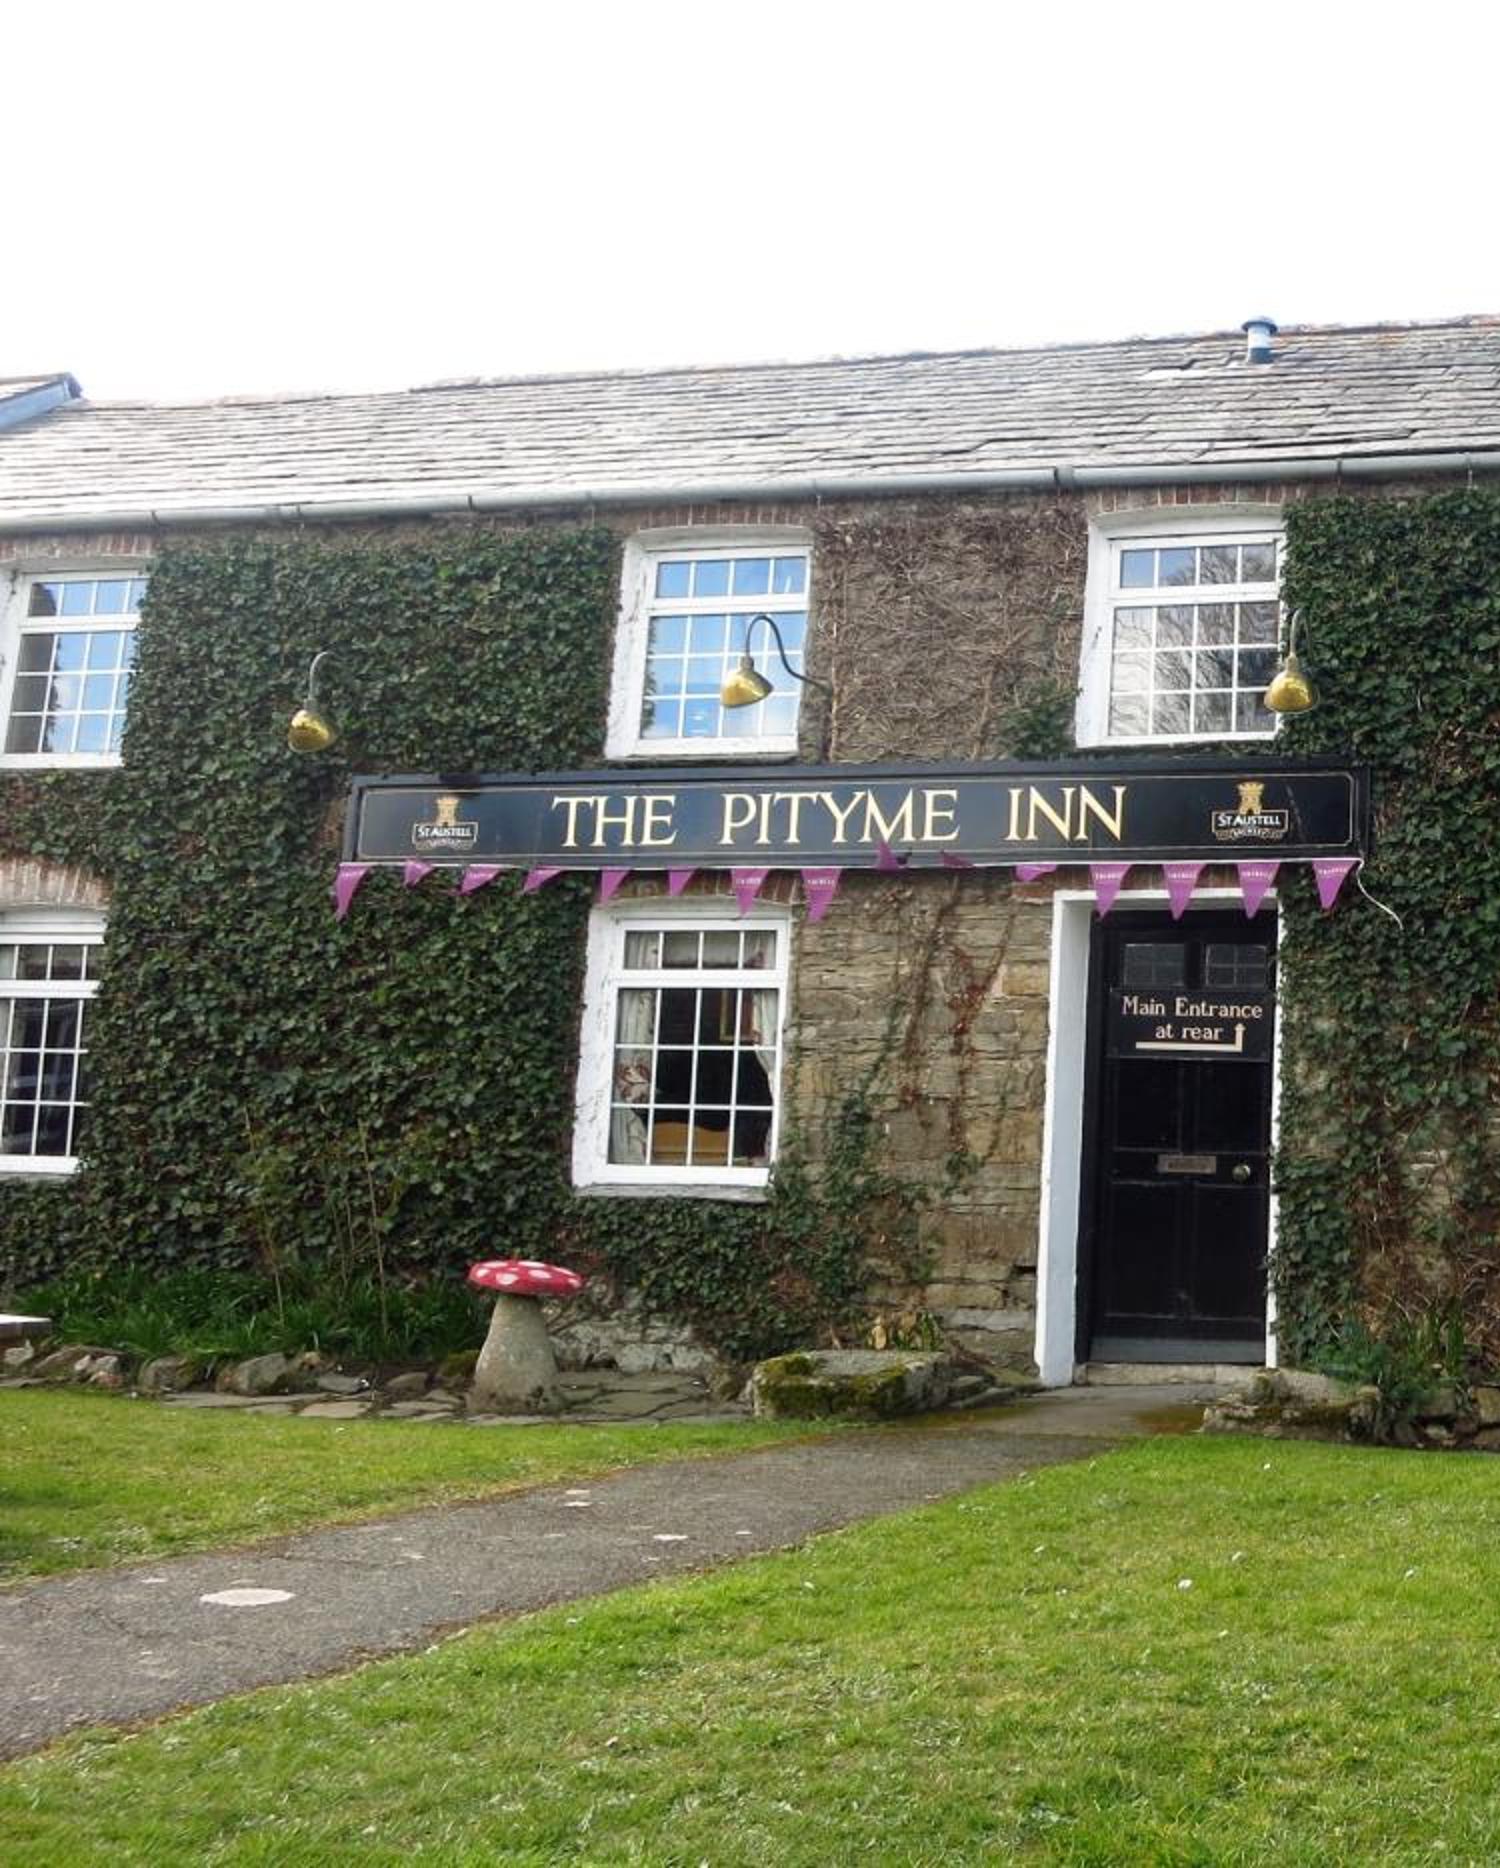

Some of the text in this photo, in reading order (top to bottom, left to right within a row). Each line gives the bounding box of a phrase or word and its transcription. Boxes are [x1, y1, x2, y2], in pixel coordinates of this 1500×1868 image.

[551, 785, 1127, 847] THE PITYME INN
[1233, 814, 1281, 827] AUSTELL
[431, 826, 472, 837] AUSTELL
[1121, 995, 1263, 1019] Main Entrance
[1155, 1023, 1225, 1041] at rear
